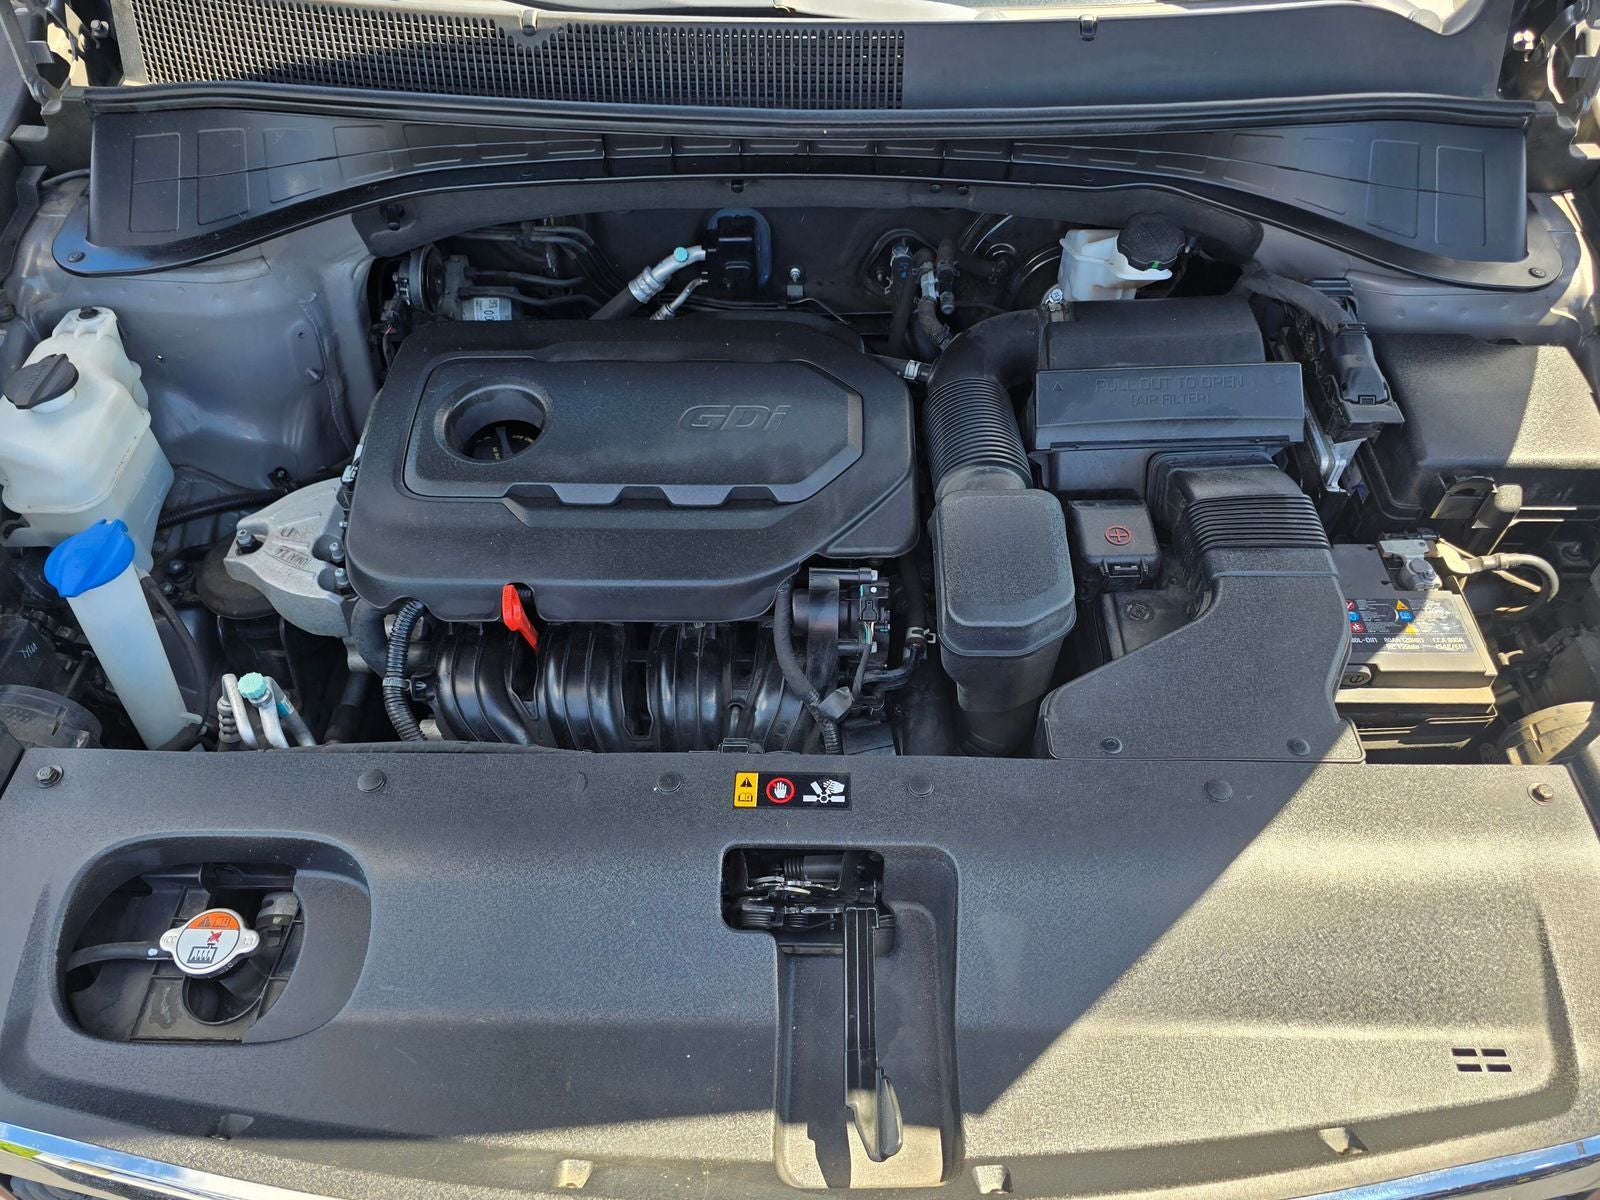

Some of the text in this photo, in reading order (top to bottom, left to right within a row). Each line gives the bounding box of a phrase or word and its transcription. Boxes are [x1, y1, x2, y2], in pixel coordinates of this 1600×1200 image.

[1095, 374, 1244, 392] PULL OUT TO OPEN
